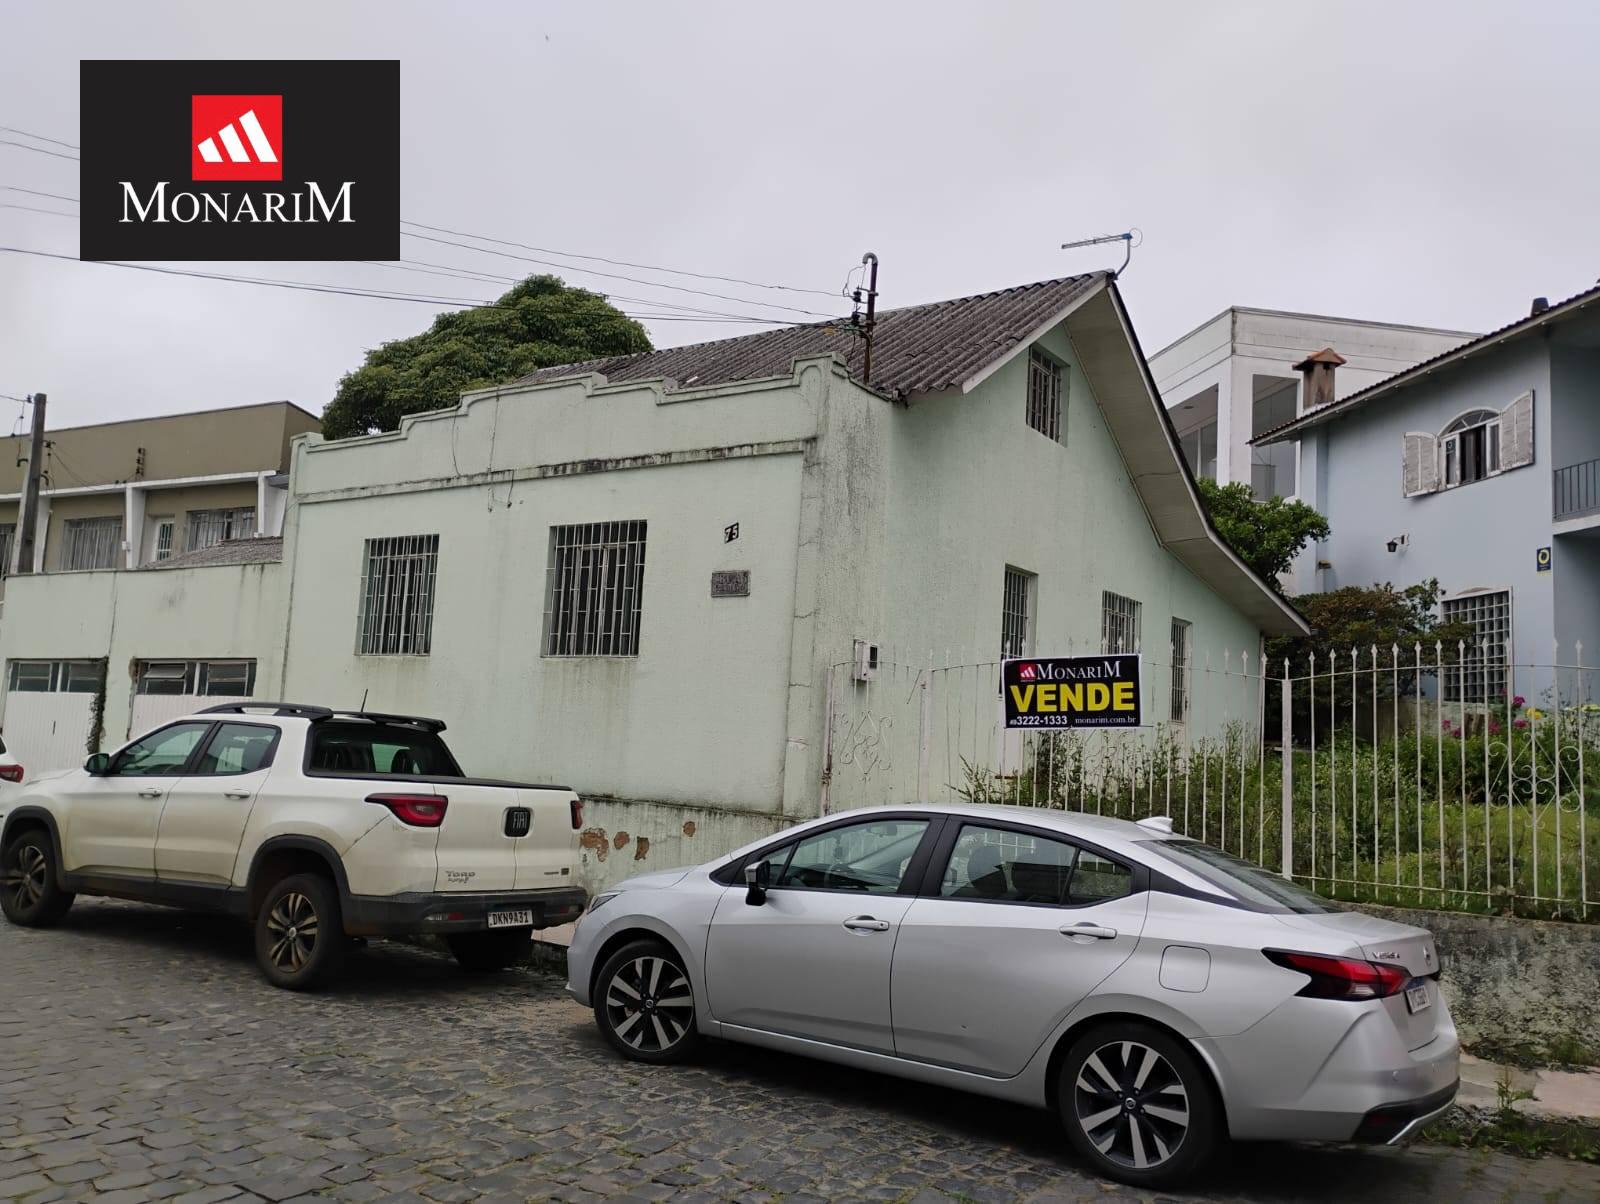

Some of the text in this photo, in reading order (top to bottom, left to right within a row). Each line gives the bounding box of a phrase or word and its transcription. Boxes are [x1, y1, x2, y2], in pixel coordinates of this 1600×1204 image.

[724, 523, 739, 543] 75
[1037, 660, 1121, 680] MONARIM
[1009, 682, 1136, 713] VENDE
[1017, 715, 1068, 725] 3222-1333
[1075, 716, 1137, 725] monarim.com.br
[512, 811, 528, 828] FIAT
[492, 911, 529, 925] DKN9A31
